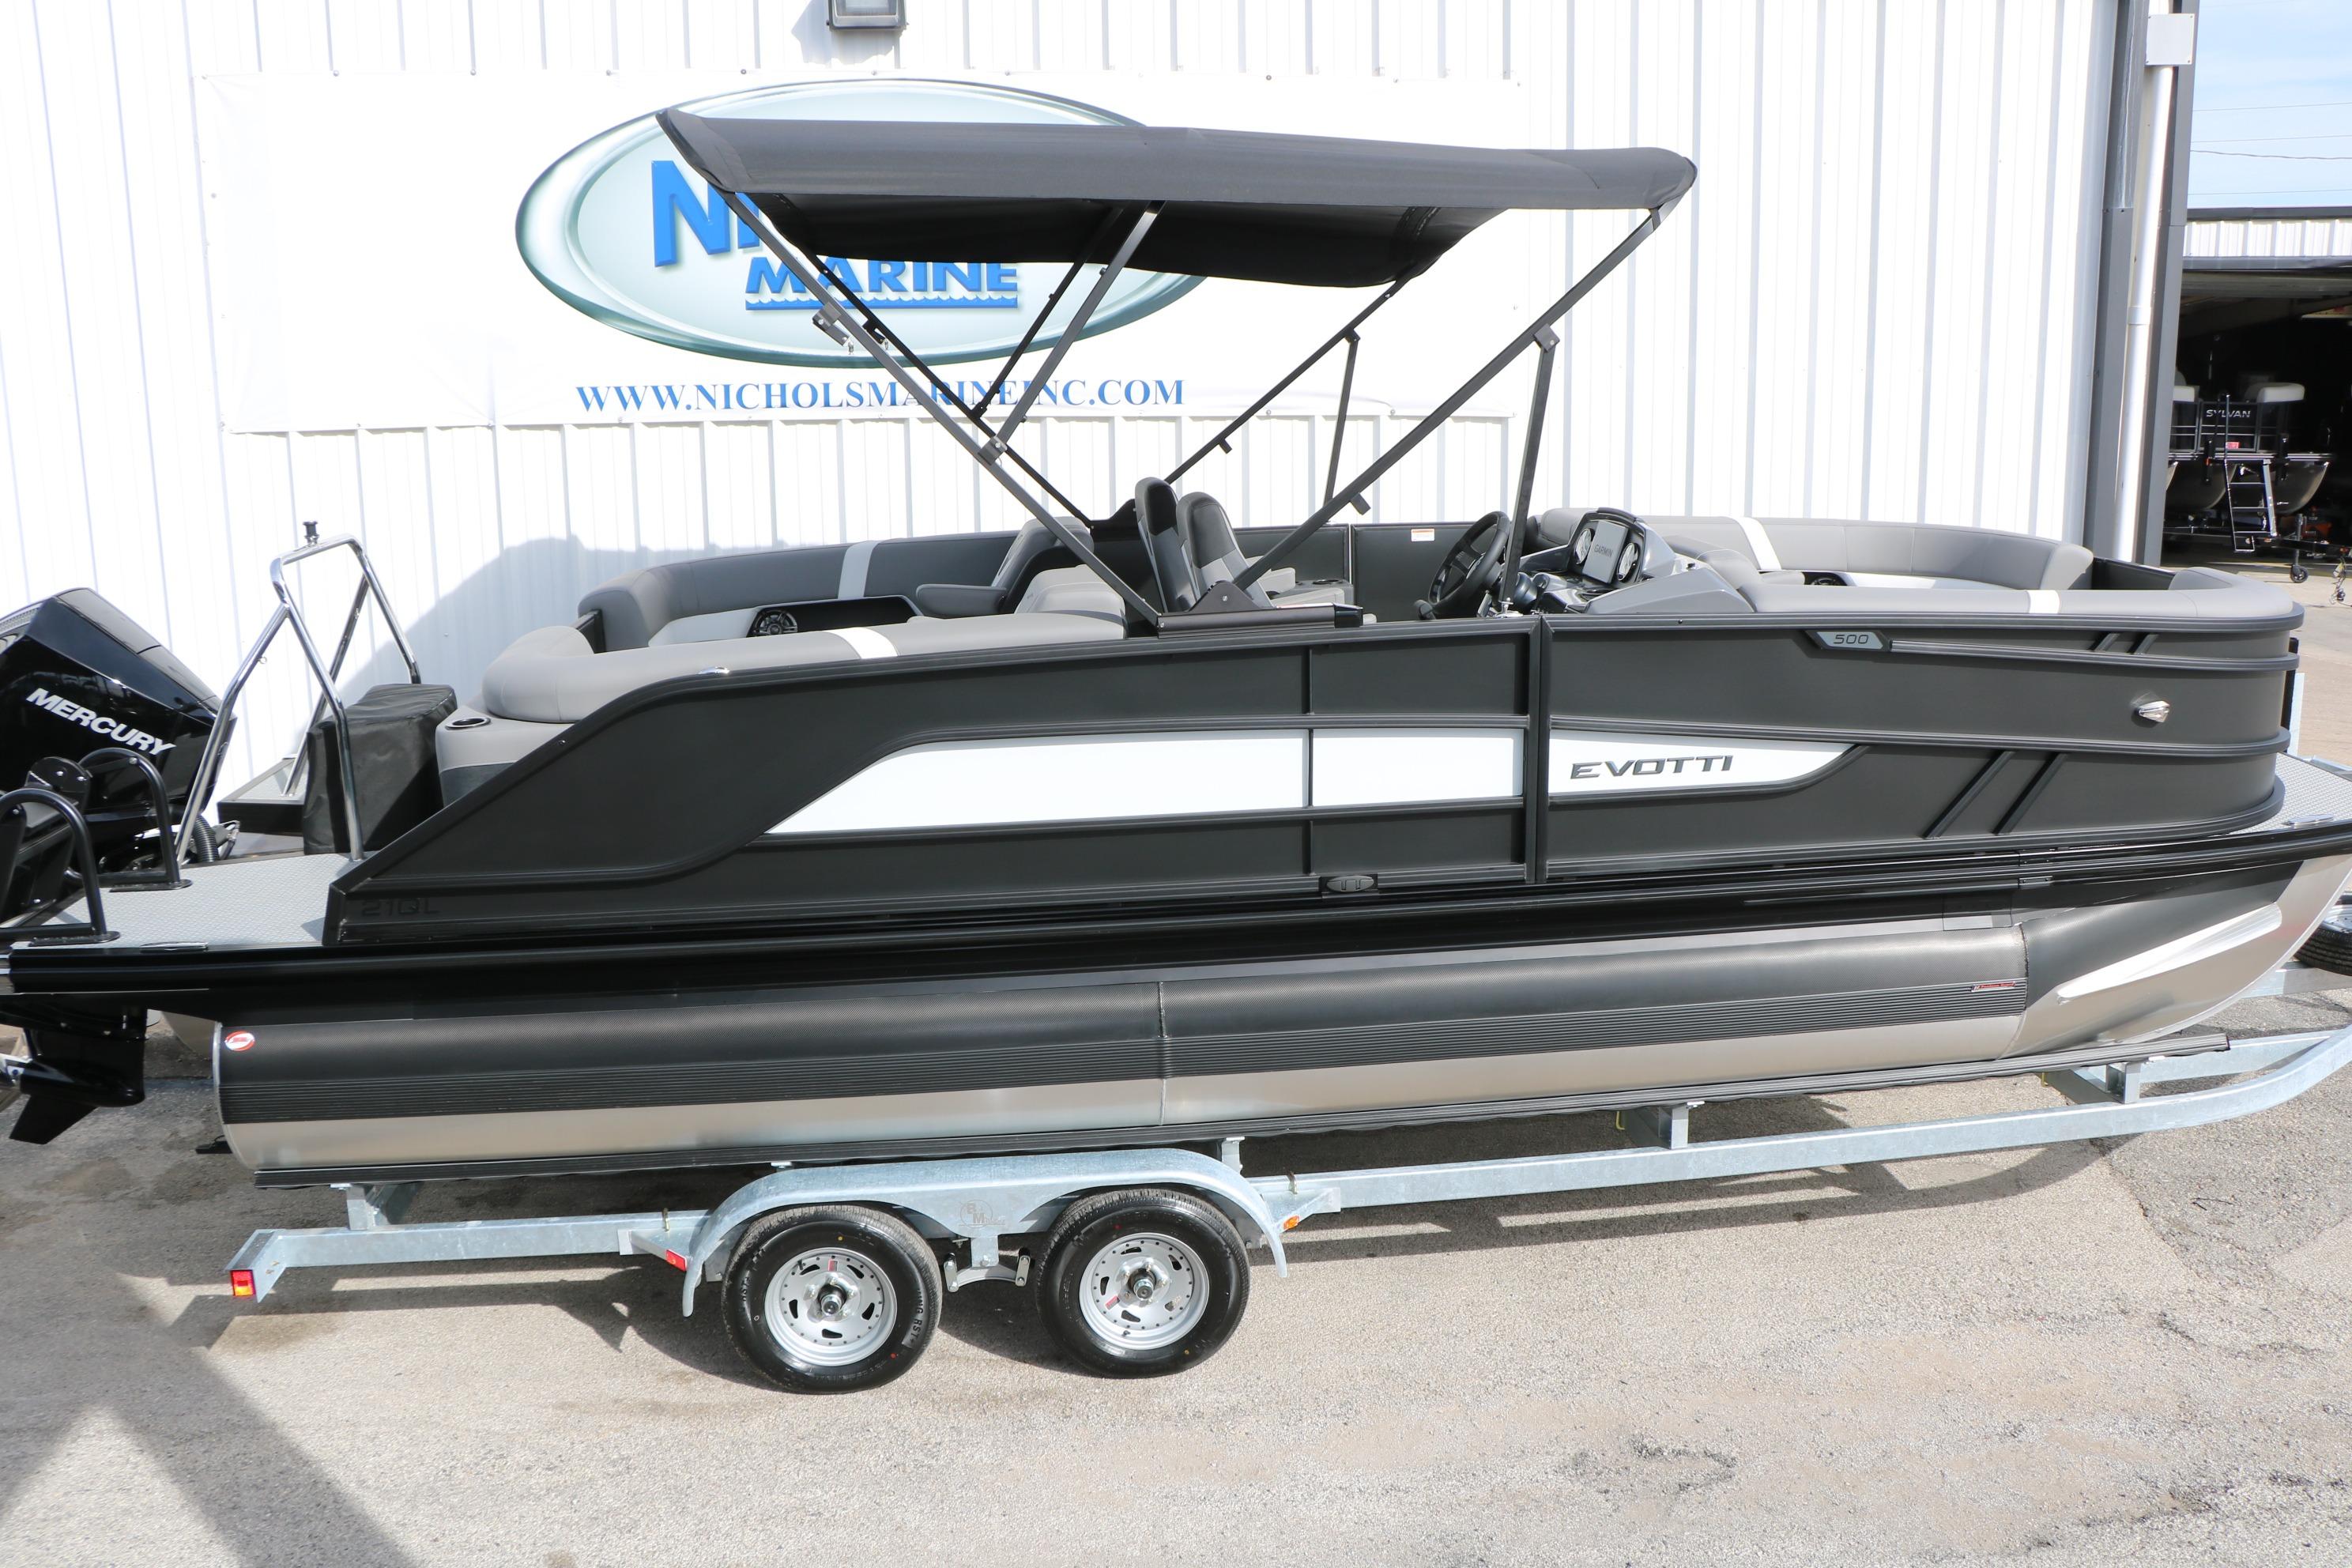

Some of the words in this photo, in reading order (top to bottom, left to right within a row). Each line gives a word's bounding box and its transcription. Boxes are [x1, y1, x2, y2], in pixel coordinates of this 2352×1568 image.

[745, 254, 1018, 294] MARINE
[575, 379, 1185, 412] WWW.NICHOLSMRINENC.COM
[2206, 409, 2251, 418] SYLVAN
[1834, 634, 1869, 644] 500
[26, 688, 176, 756] MERCURY
[1570, 755, 1733, 779] EVOTTI
